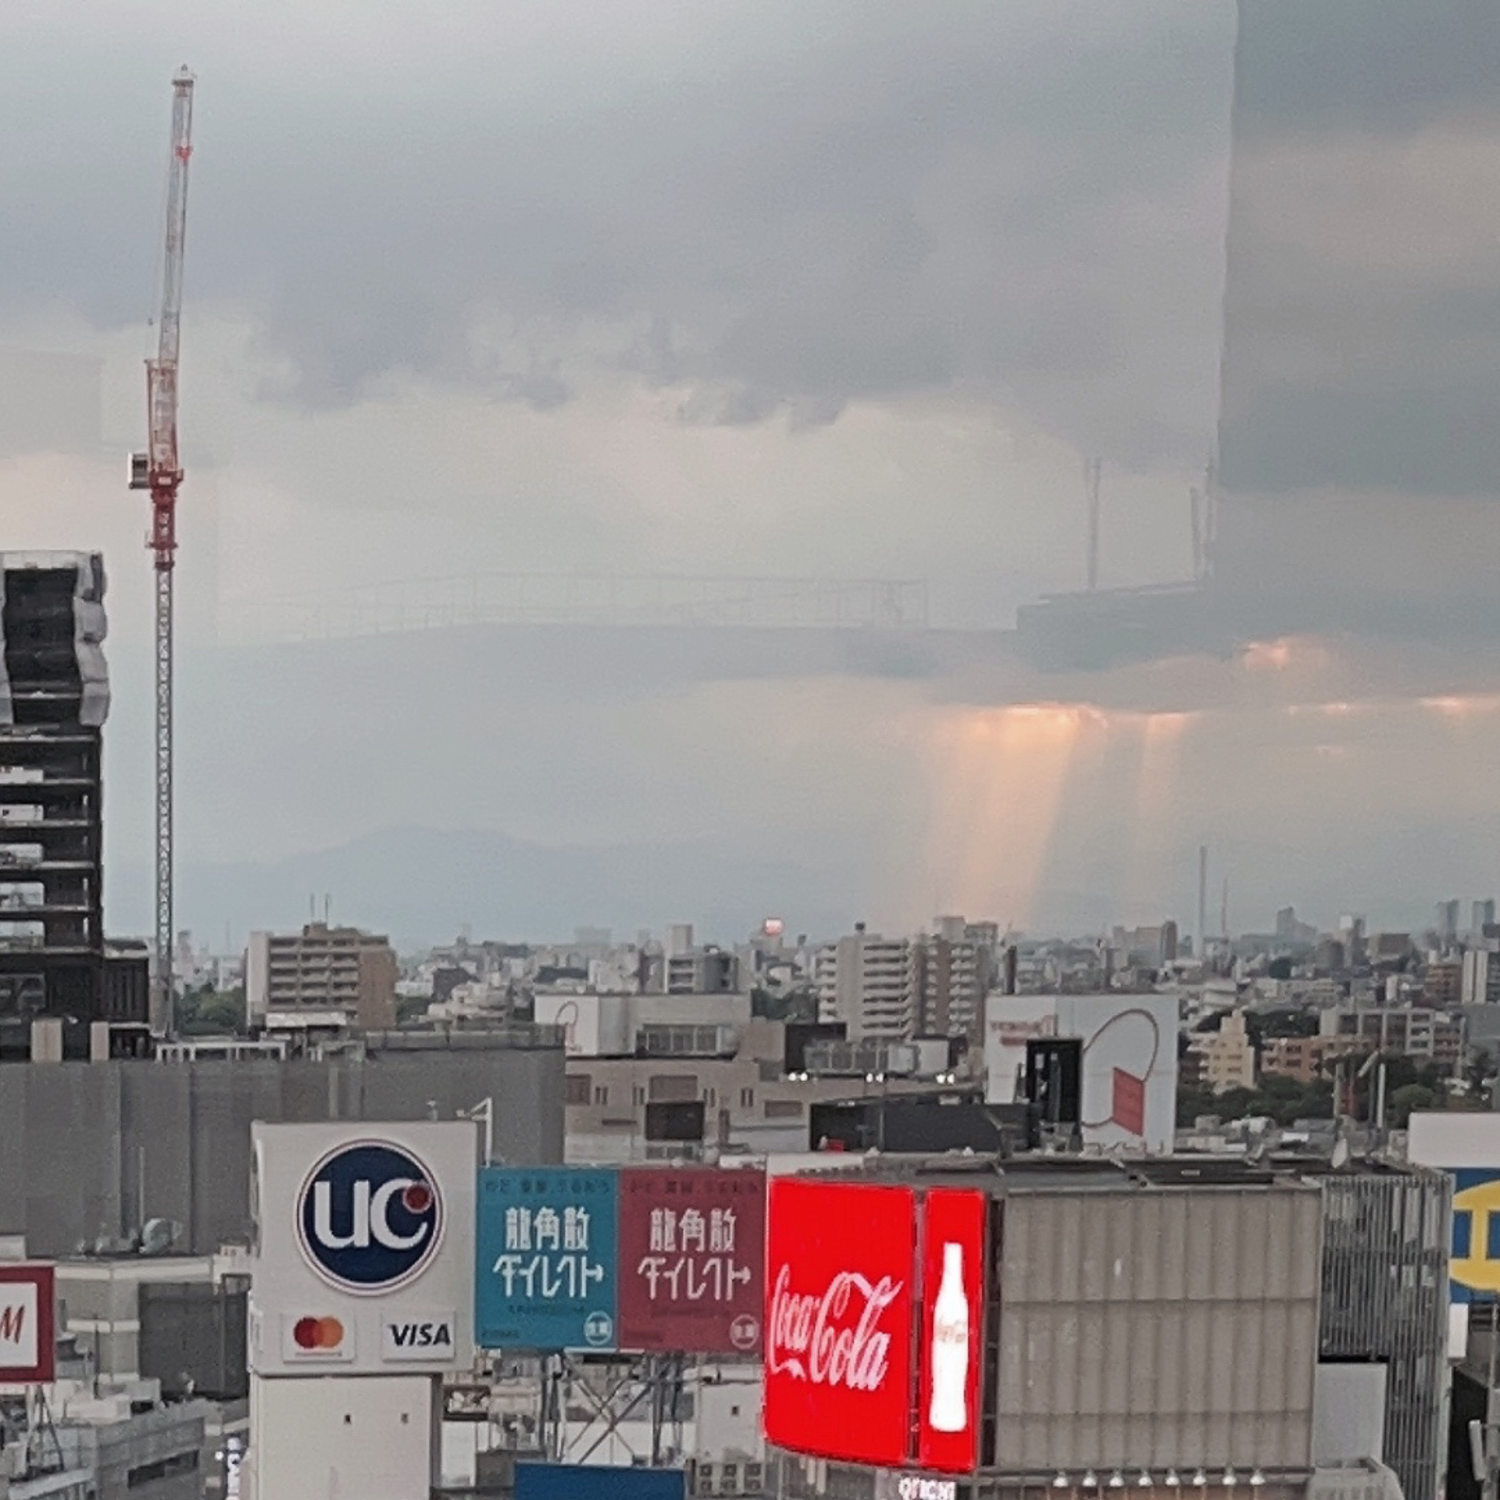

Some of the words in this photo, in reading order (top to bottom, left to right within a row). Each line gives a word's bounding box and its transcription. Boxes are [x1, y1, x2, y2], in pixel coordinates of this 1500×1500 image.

[505, 1207, 590, 1251] 龍角散
[650, 1208, 737, 1252] 龍角散
[492, 1254, 605, 1299] ダイレクト
[637, 1256, 753, 1301] ダイレクト
[390, 1324, 451, 1347] VISA
[769, 1264, 904, 1392] Coca-Cola
